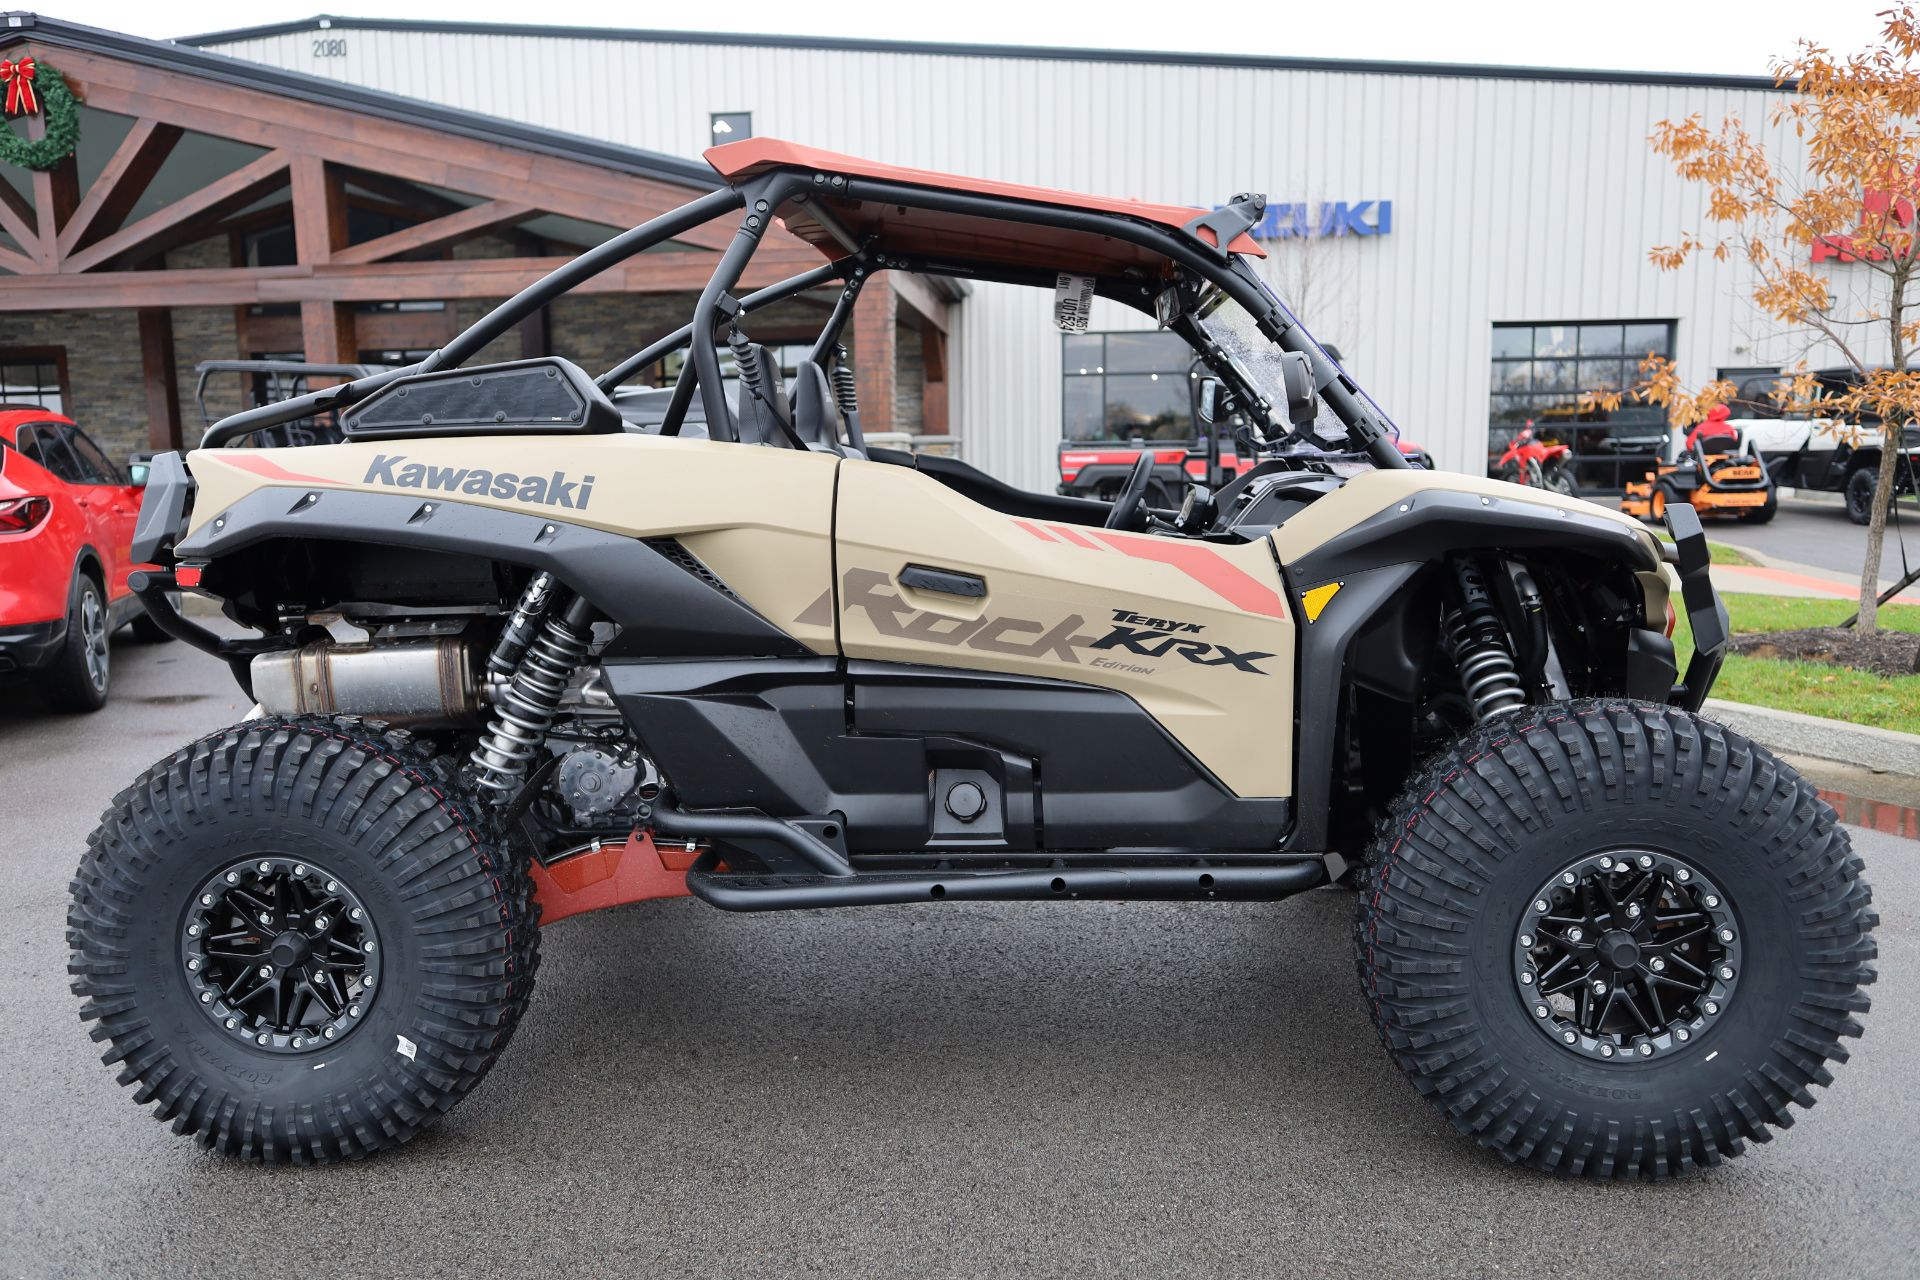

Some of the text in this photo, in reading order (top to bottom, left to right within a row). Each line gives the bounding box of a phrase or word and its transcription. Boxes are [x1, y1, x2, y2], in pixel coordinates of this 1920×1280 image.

[312, 38, 347, 58] 2080
[1060, 298, 1078, 332] U01524
[363, 454, 596, 511] Kawasaki
[793, 567, 1098, 664] Rock
[1089, 625, 1279, 676] KRX
